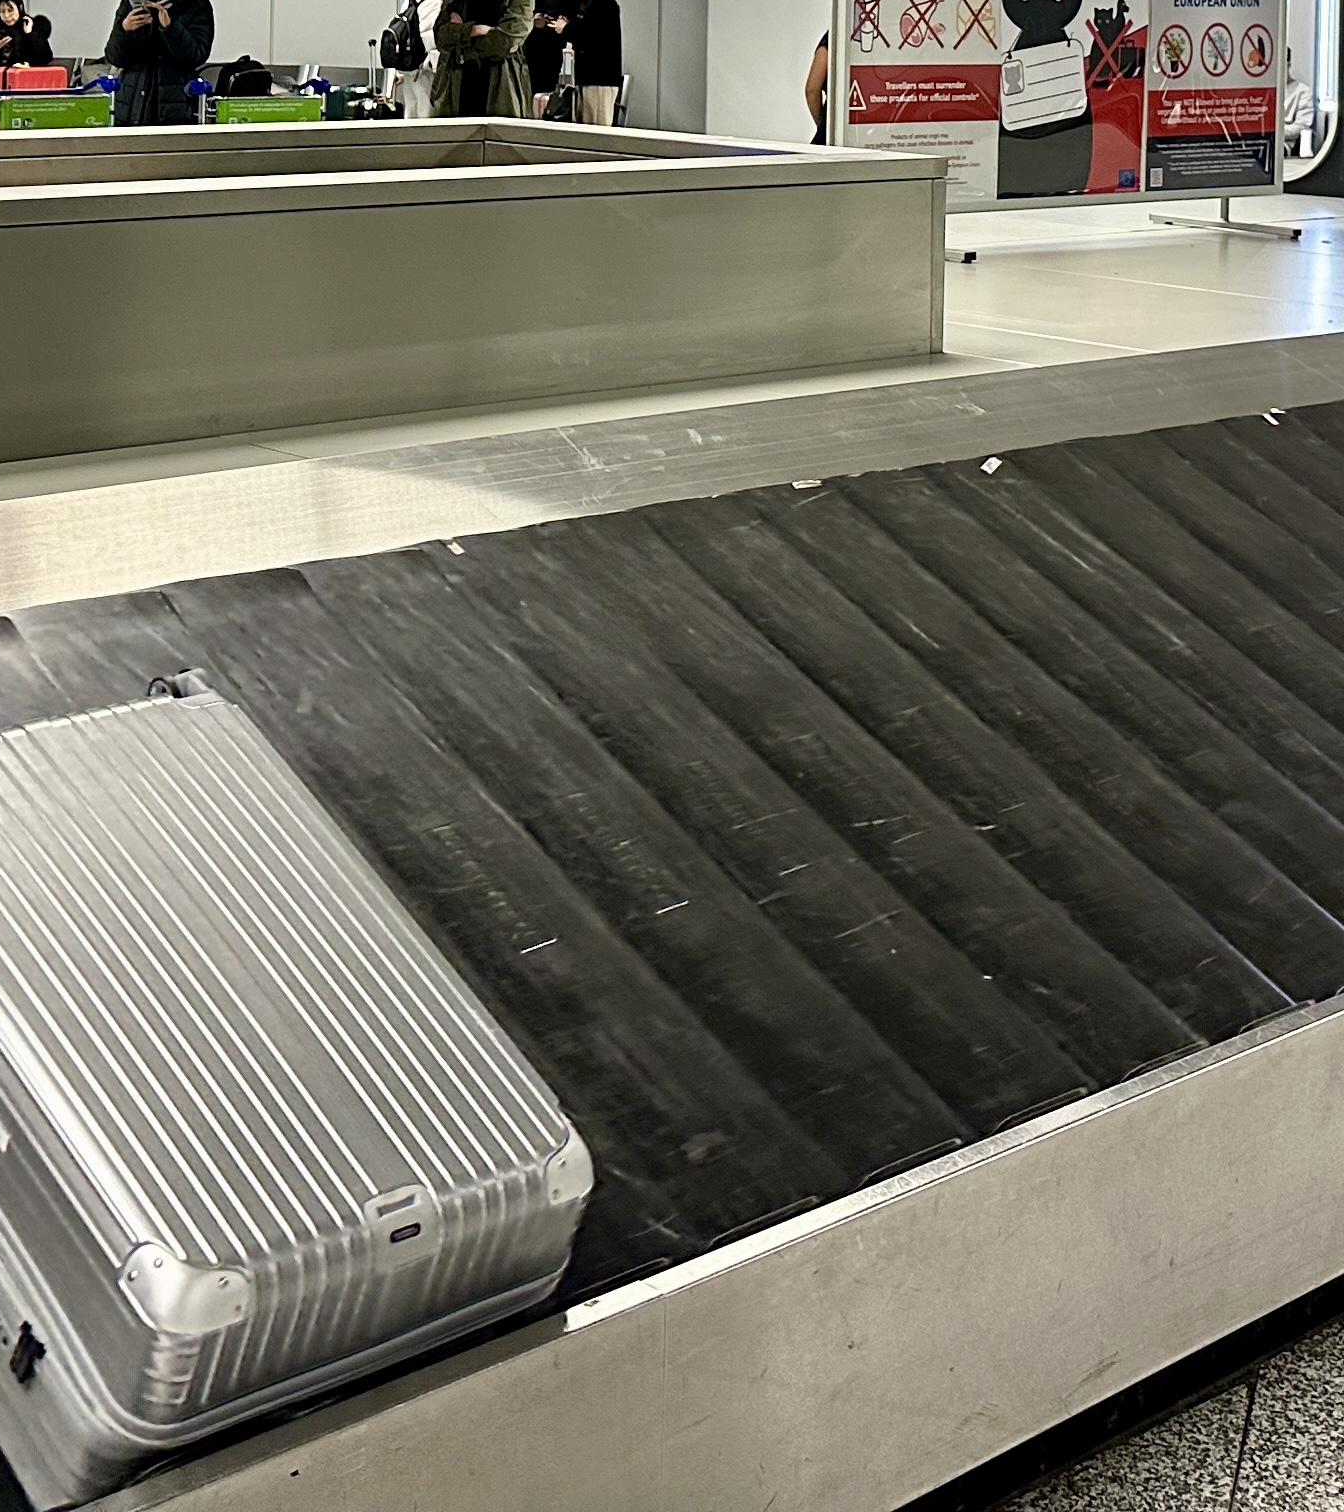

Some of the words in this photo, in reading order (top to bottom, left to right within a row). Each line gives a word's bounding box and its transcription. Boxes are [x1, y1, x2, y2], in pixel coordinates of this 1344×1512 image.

[885, 81, 916, 90] Travellers
[936, 81, 966, 89] surrender
[889, 93, 917, 104] products
[919, 93, 929, 101] for
[930, 93, 950, 102] official
